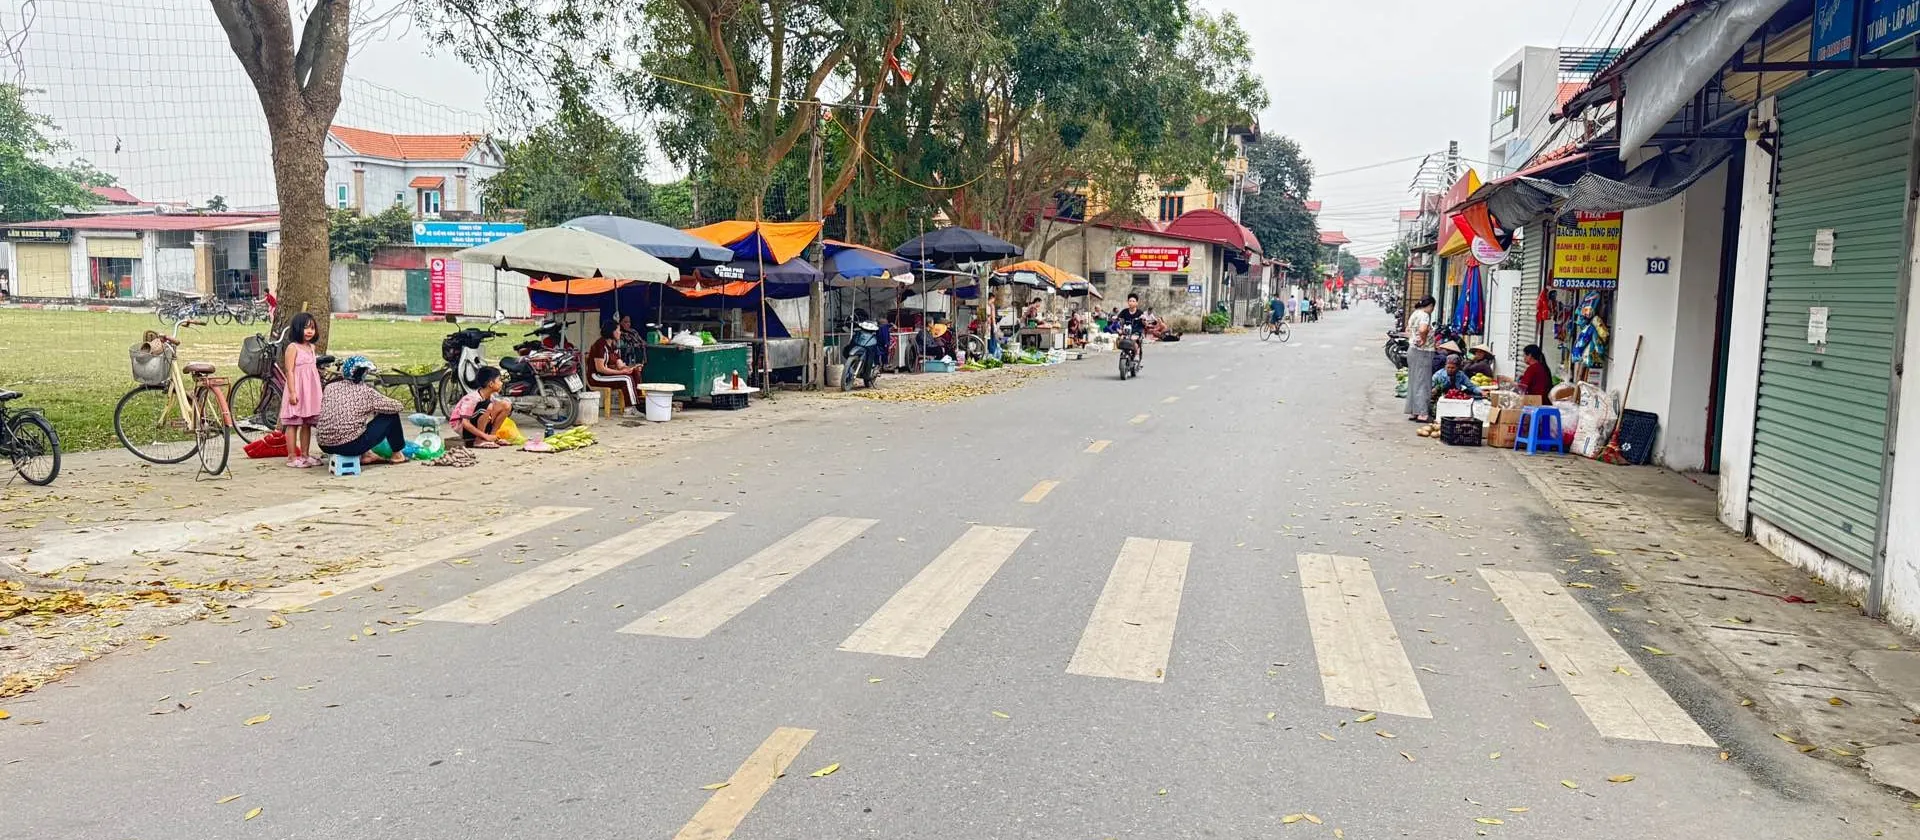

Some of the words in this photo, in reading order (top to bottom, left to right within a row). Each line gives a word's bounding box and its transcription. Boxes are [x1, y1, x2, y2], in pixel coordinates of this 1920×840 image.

[1650, 260, 1665, 272] 90
[1553, 279, 1565, 288] ĐT:
[1566, 279, 1616, 288] 0326.643.123
